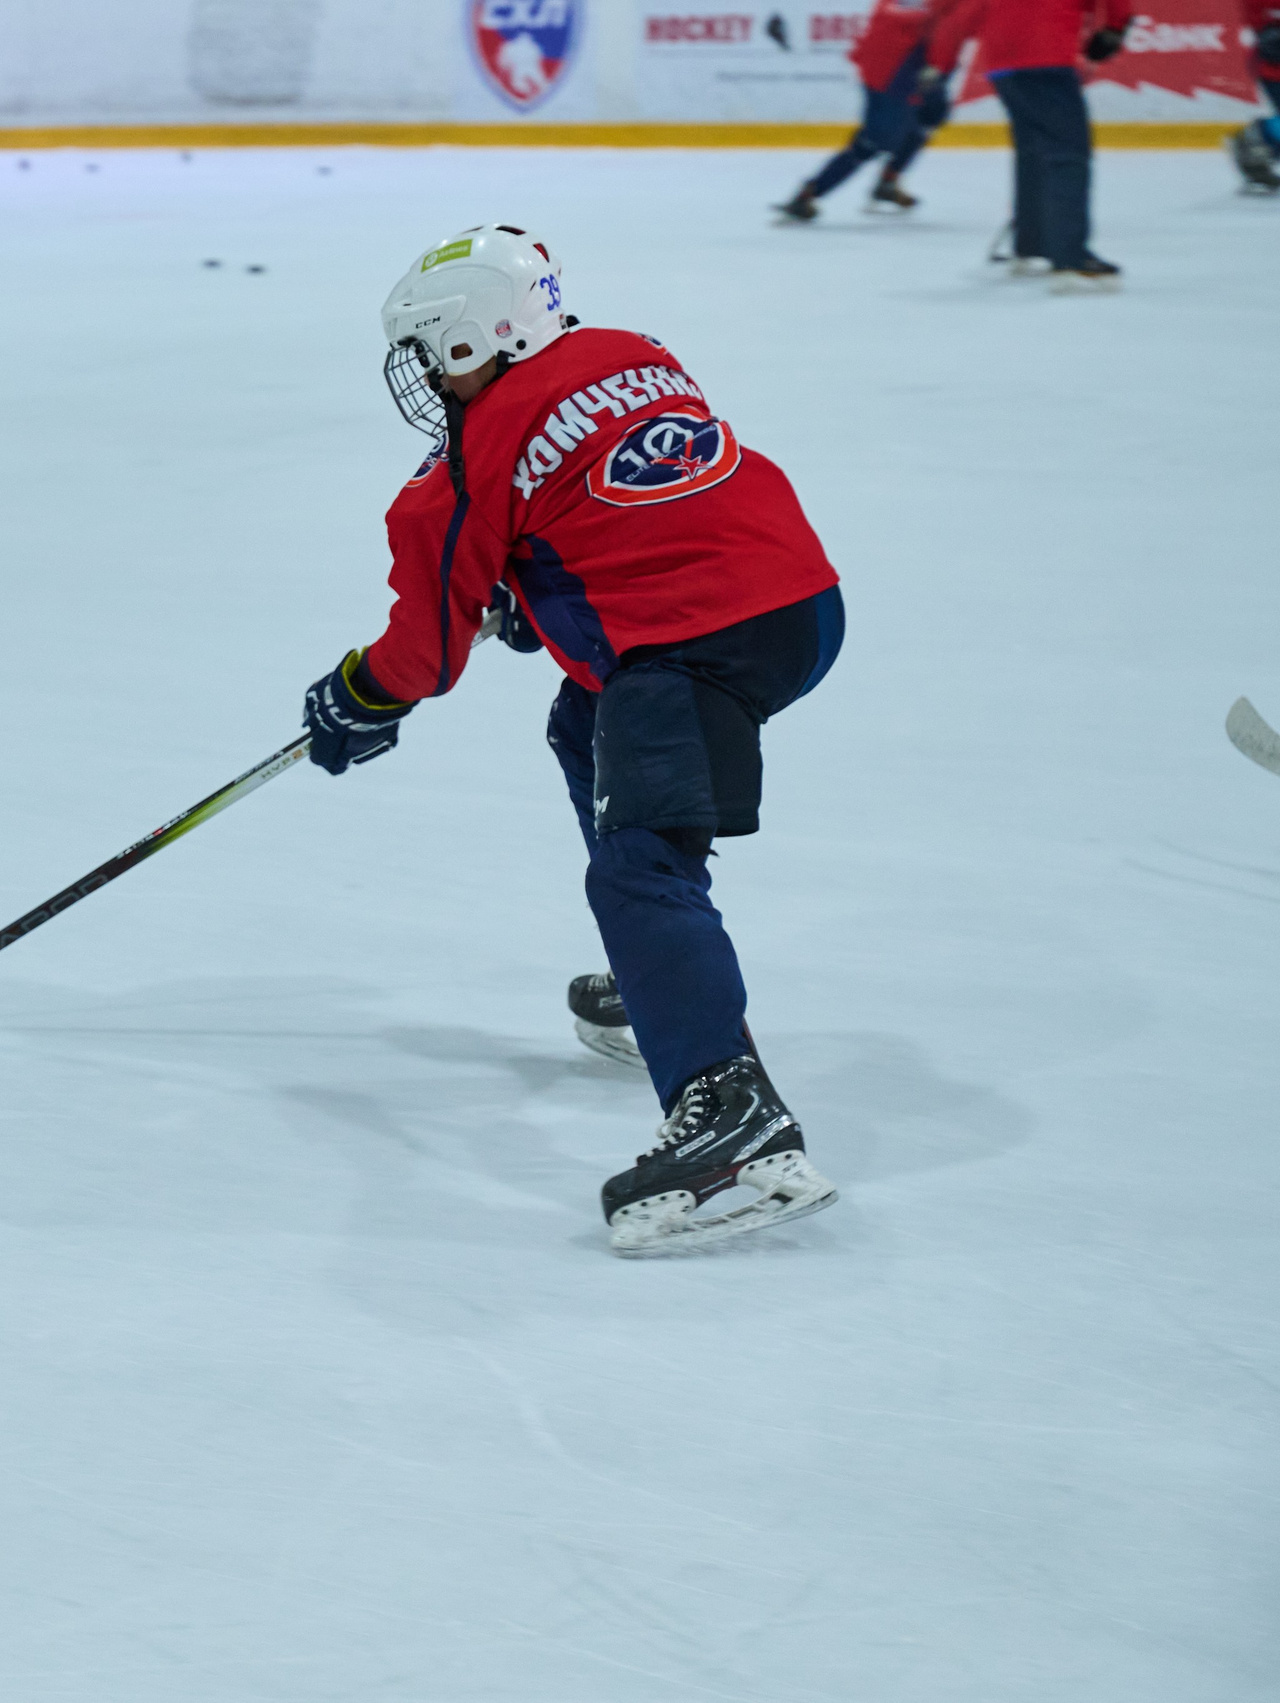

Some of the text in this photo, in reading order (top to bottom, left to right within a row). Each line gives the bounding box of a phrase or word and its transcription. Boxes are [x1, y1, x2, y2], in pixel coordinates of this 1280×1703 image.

[645, 14, 752, 43] HOCKEY
[540, 273, 561, 311] 39
[415, 315, 441, 329] CCM
